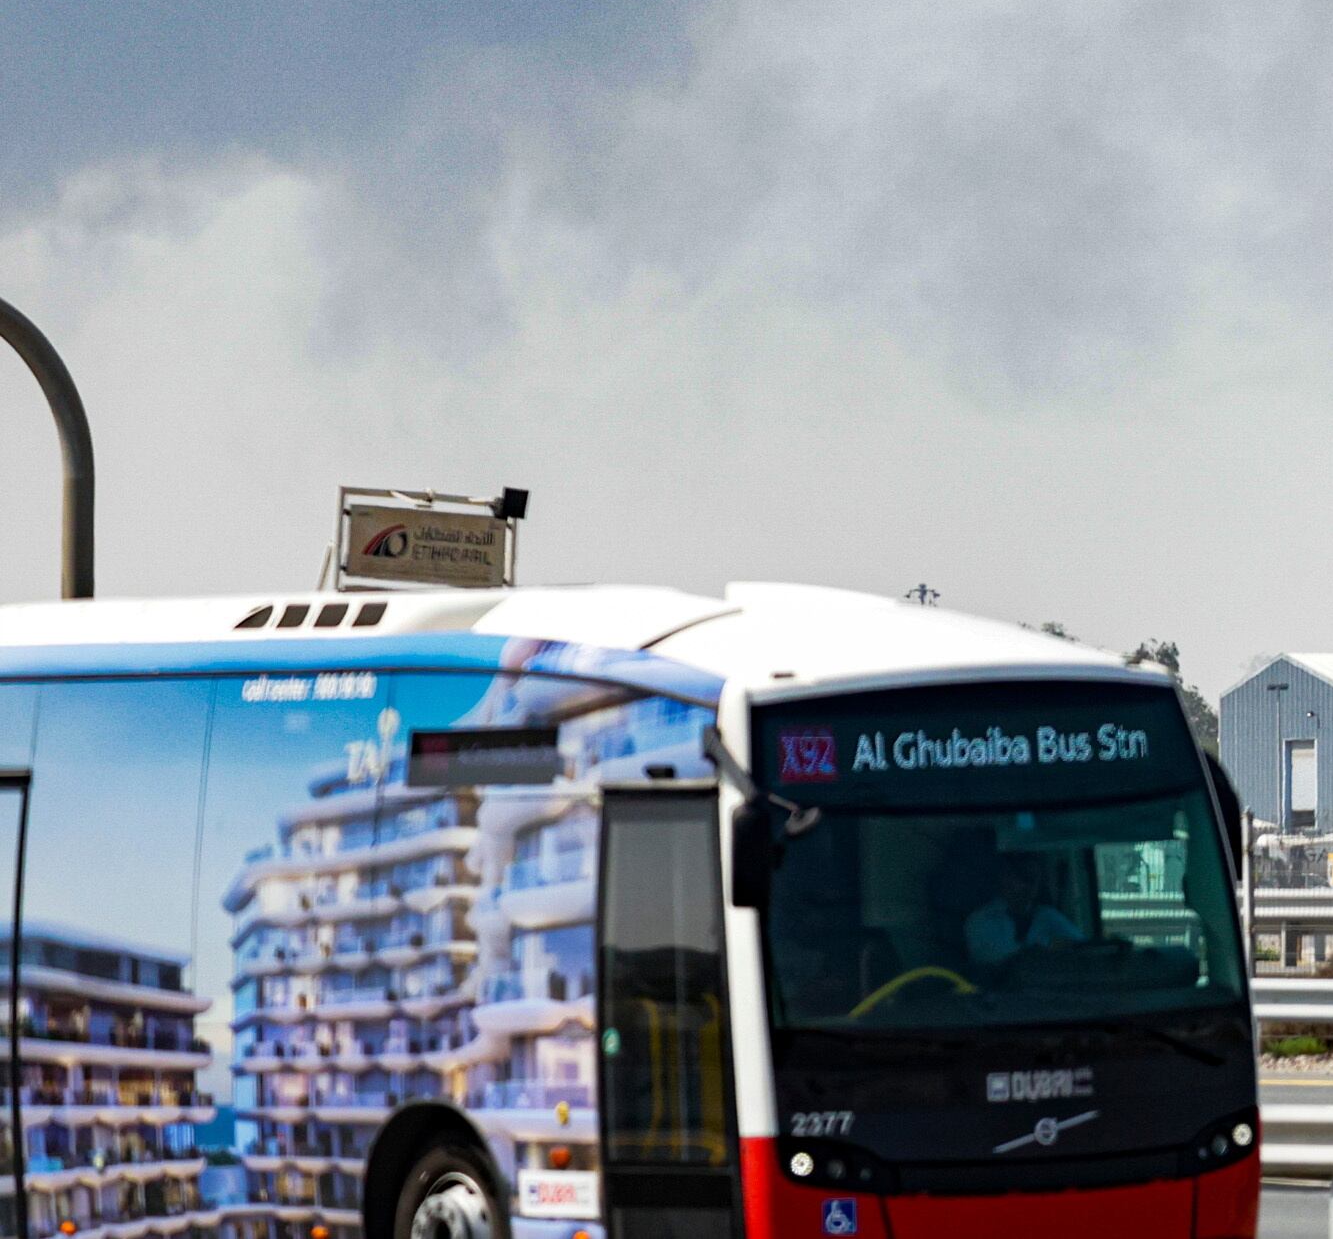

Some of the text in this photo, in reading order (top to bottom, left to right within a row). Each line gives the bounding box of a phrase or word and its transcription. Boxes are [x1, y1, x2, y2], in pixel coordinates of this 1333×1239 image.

[781, 731, 834, 774] X92
[893, 726, 1029, 769] Ghubaiba
[1037, 724, 1091, 762] Bus
[1097, 722, 1147, 761] Stn
[791, 1111, 853, 1137] 2377
